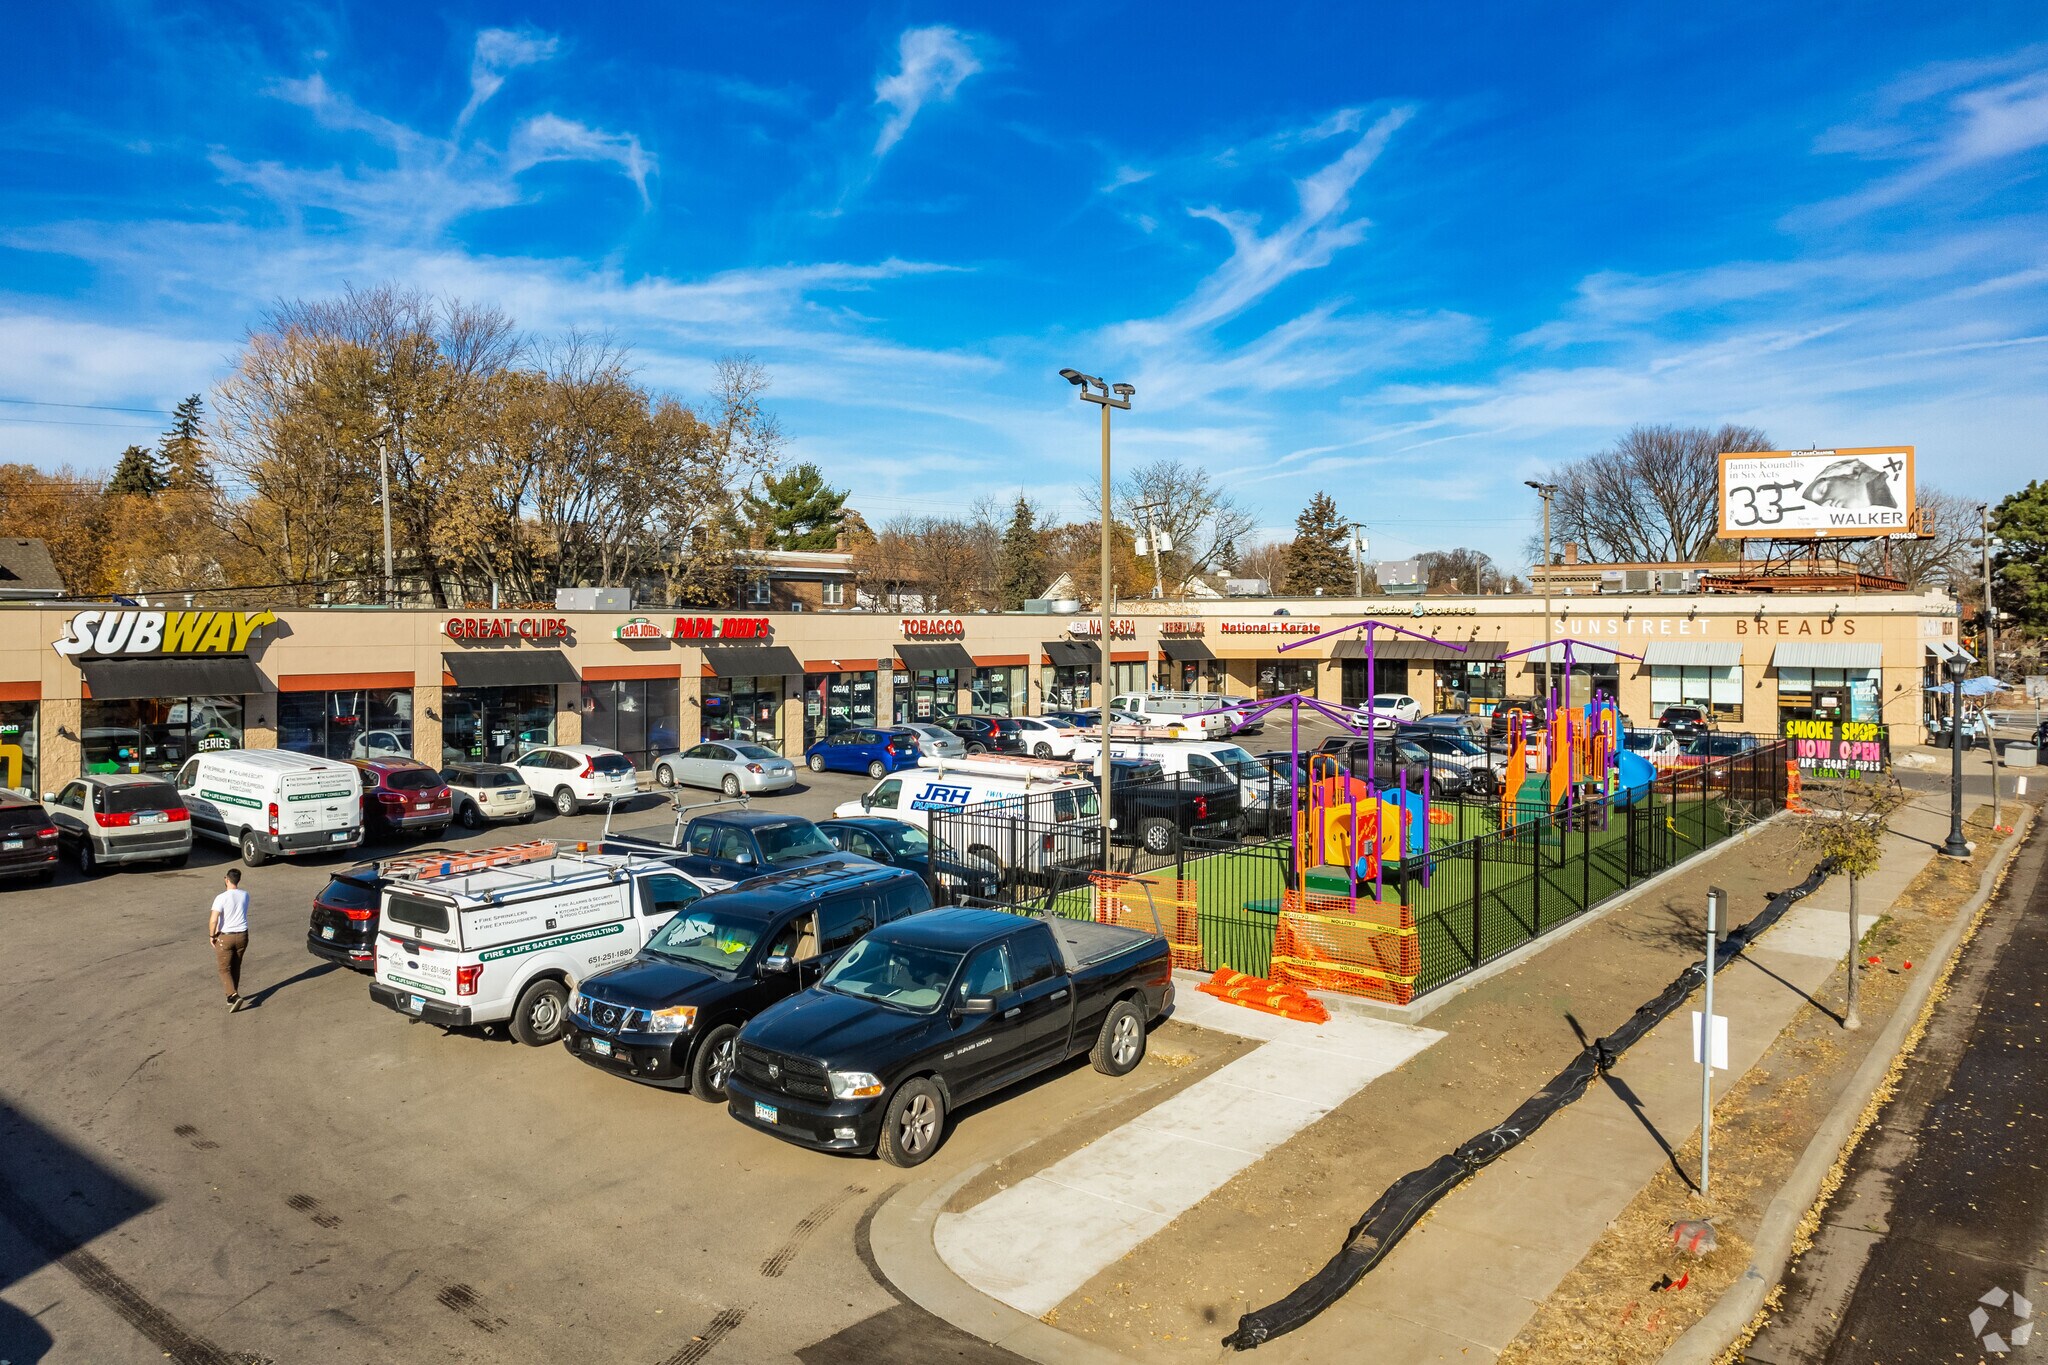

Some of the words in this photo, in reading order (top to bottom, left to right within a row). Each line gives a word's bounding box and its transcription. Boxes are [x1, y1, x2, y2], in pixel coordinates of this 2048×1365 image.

[1729, 462, 1758, 470] Jannis
[1759, 459, 1805, 469] Kounellis
[1729, 471, 1738, 479] in
[1741, 471, 1756, 479] Six
[1759, 470, 1780, 478] Acts
[1830, 512, 1903, 525] WALKER
[1425, 606, 1476, 615] COFFEE
[446, 617, 513, 639] GREAT
[518, 617, 567, 638] CLIPS
[622, 627, 639, 638] PAPA
[672, 617, 714, 639] PAPA
[719, 617, 769, 639] JOHN'S
[902, 619, 964, 635] TOBACCO
[1119, 620, 1136, 635] SPA
[1221, 622, 1271, 632] National
[1281, 622, 1320, 632] Karate
[1554, 619, 1711, 635] SUNSTREET
[1736, 619, 1855, 635] BREADS
[51, 608, 277, 658] SUBWAY
[893, 675, 909, 684] OPEN
[832, 685, 849, 694] CIGAR
[854, 705, 871, 713] GLASS
[1786, 720, 1834, 740] SMOKE
[198, 737, 231, 751] SERIES
[1798, 740, 1831, 759] NOW
[1839, 741, 1880, 761] OPEN
[1855, 760, 1881, 771] PIPES
[916, 783, 972, 804] JRH
[986, 790, 1002, 798] TWIN
[593, 894, 613, 902] SECURITY
[493, 910, 528, 920] SPRINKLERS
[494, 916, 538, 928] EXTINGUISHERS
[1330, 919, 1356, 927] CAUTION
[1377, 925, 1399, 934] CAUTION
[483, 950, 505, 960] FIRE
[512, 944, 532, 954] LIFE
[532, 938, 563, 950] SAFETY
[570, 927, 619, 941] CONSULTING
[1291, 958, 1317, 966] CAUTION
[1339, 966, 1365, 974] CAUTION
[1385, 973, 1407, 983] CAUTION
[957, 1044, 976, 1055] RAM
